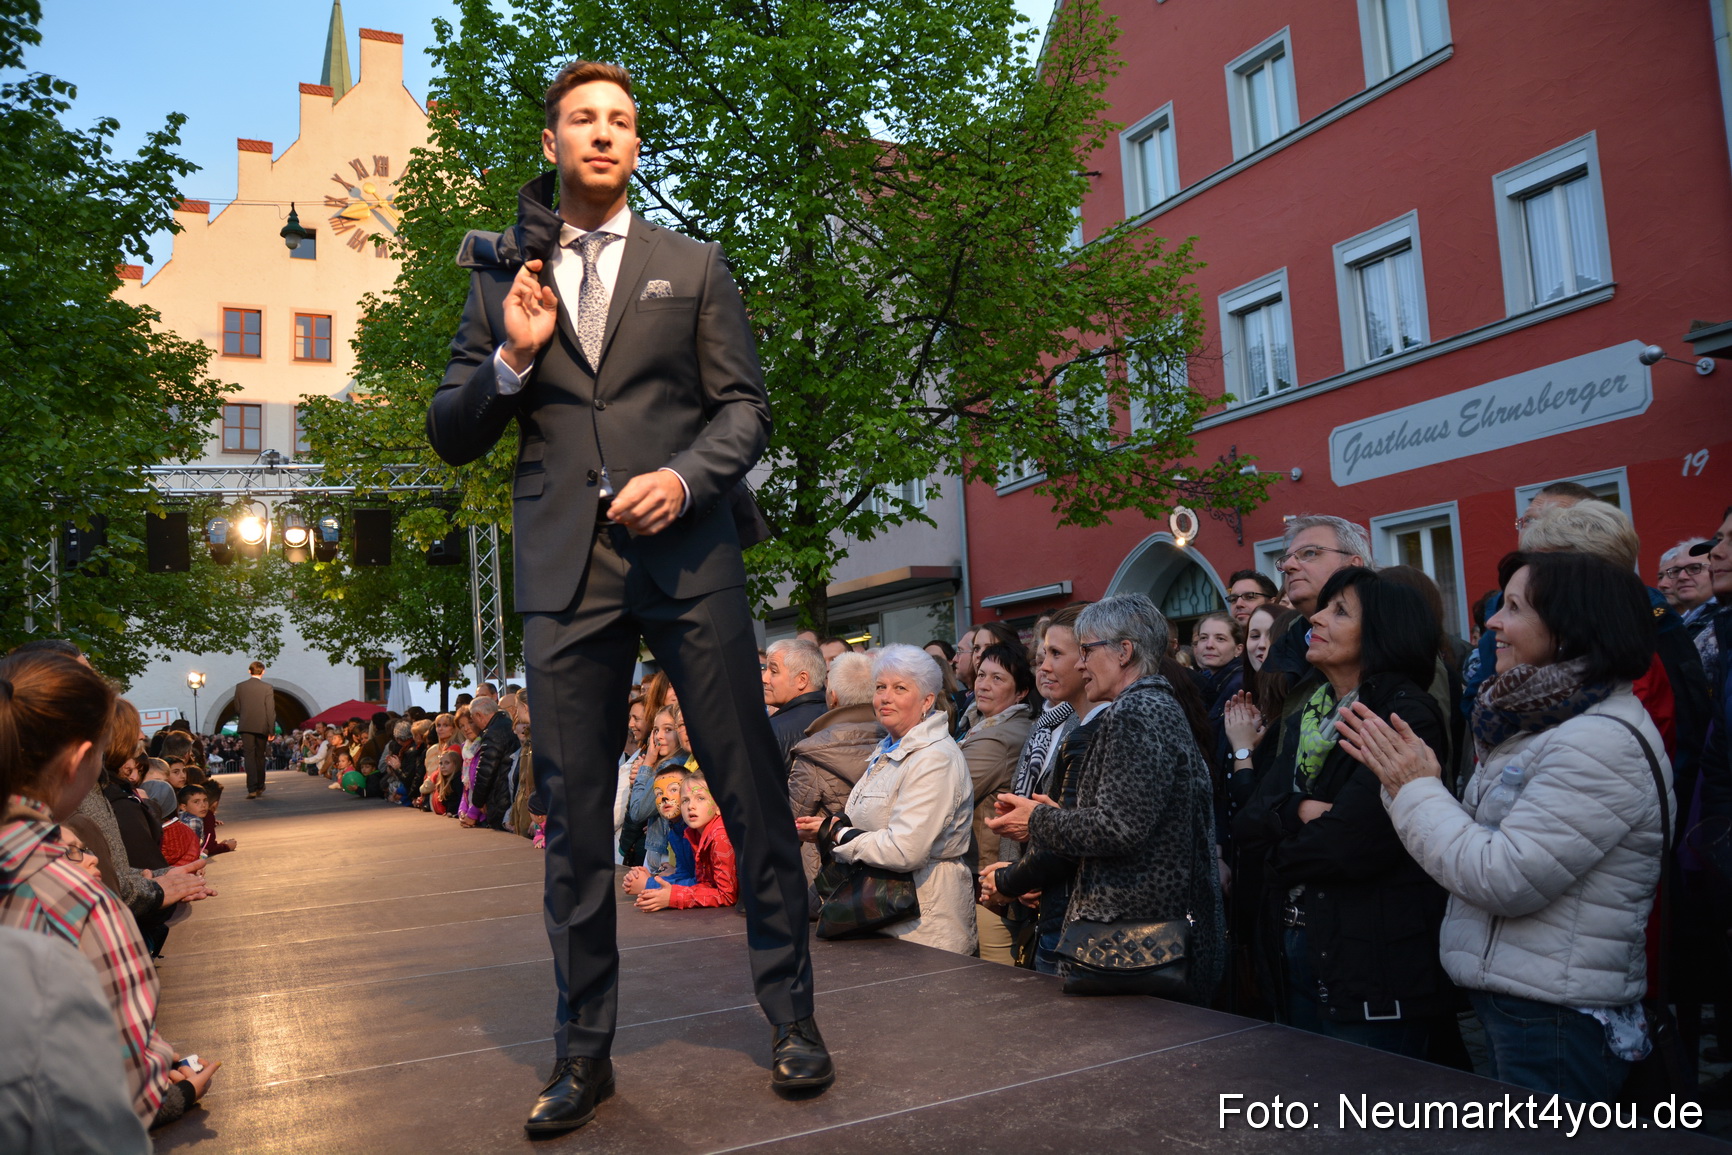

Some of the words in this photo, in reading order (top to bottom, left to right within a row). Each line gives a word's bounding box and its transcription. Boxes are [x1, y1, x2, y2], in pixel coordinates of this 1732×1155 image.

[348, 158, 370, 181] XI
[372, 155, 389, 177] XII
[331, 173, 355, 192] X
[323, 195, 349, 208] IX
[346, 228, 370, 253] VII
[1343, 420, 1451, 476] Gasthaus
[1457, 374, 1629, 438] Ehrnsberger
[1682, 448, 1710, 477] 19
